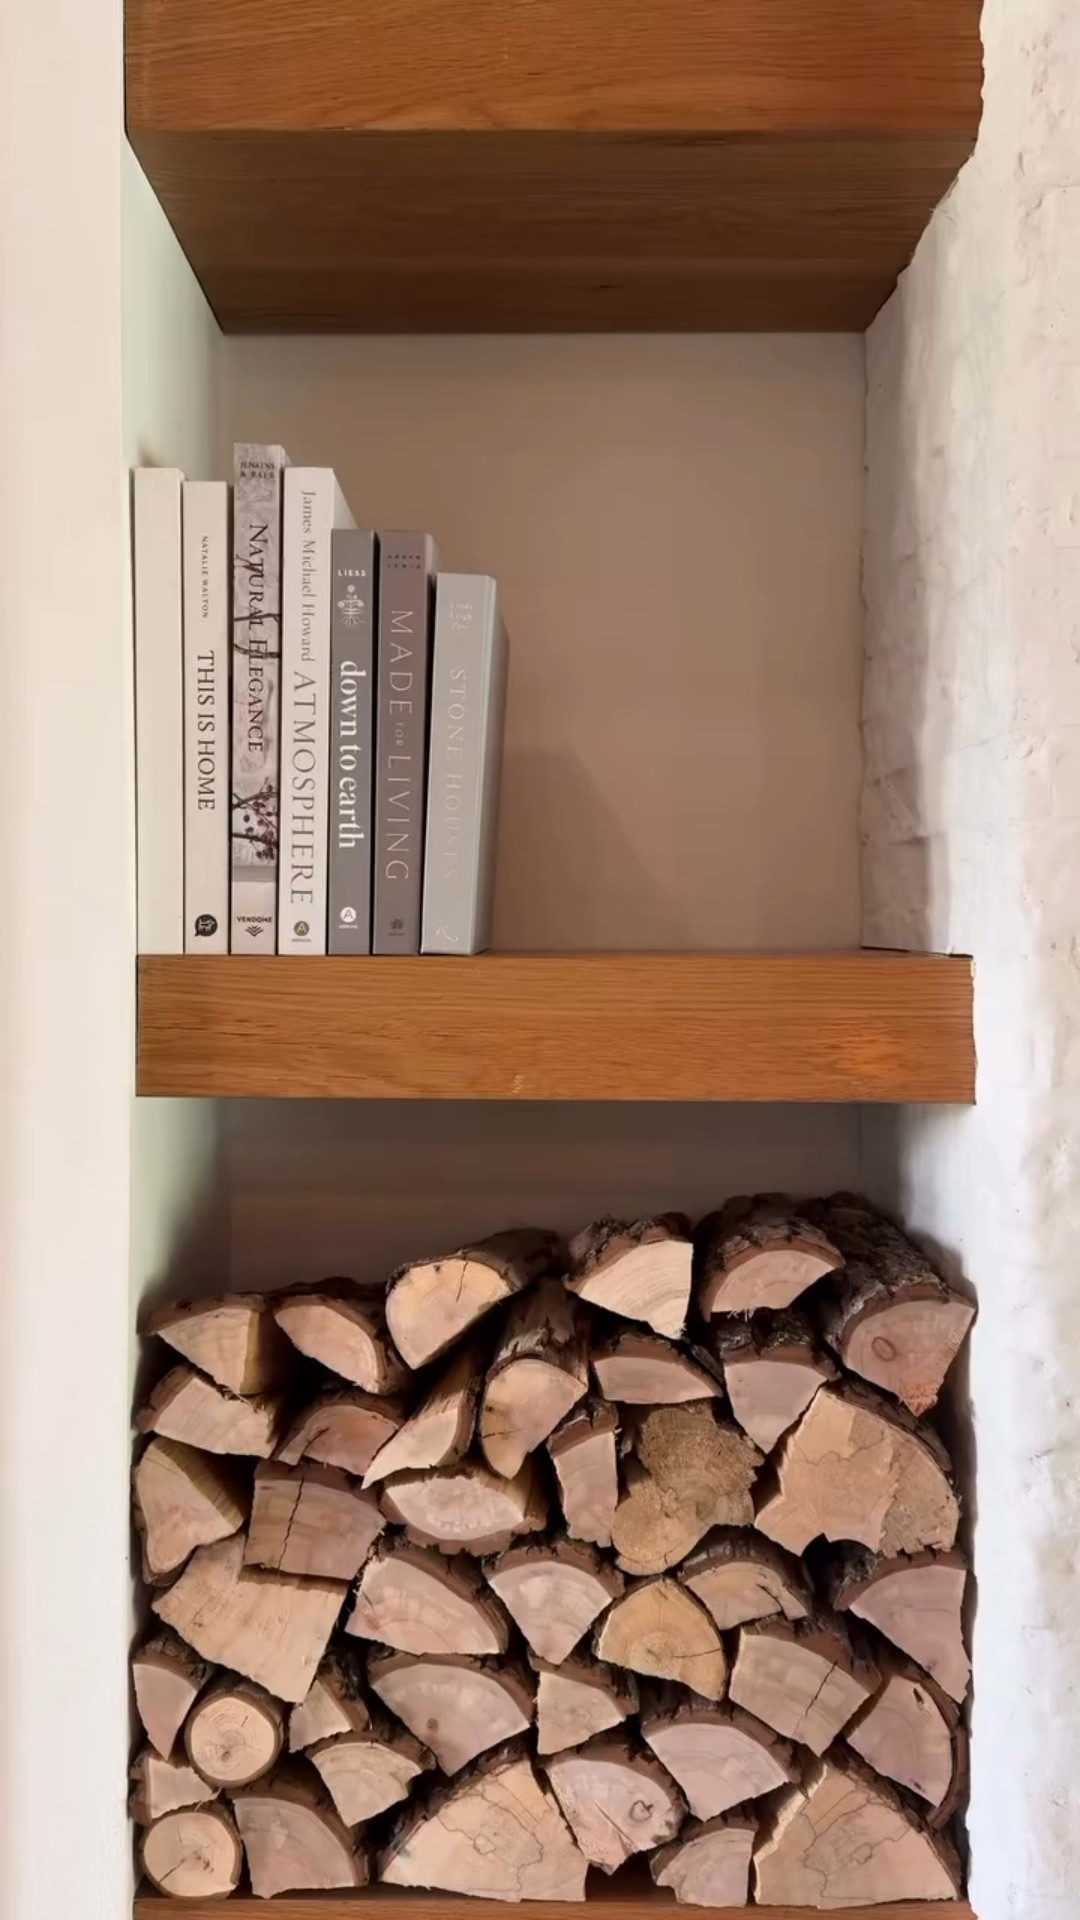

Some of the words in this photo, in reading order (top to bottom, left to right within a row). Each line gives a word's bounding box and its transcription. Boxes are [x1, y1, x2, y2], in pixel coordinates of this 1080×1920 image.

[301, 490, 317, 534] James
[201, 535, 209, 577] NATALIE
[248, 524, 269, 631] NATURAL
[301, 540, 318, 598] Michael
[201, 578, 209, 619] WALTON
[301, 604, 316, 662] Howard
[389, 609, 414, 715] MADE
[197, 650, 215, 705] THIS
[248, 639, 268, 752] ELEGANCE
[339, 660, 367, 737] down
[197, 713, 215, 732] IS
[395, 722, 405, 746] FOR
[447, 668, 466, 759] STONE
[197, 739, 216, 811] HOME
[290, 670, 317, 904] ATMOSPHERE
[339, 744, 362, 771] to
[338, 776, 365, 849] earth
[385, 755, 412, 880] LIVING
